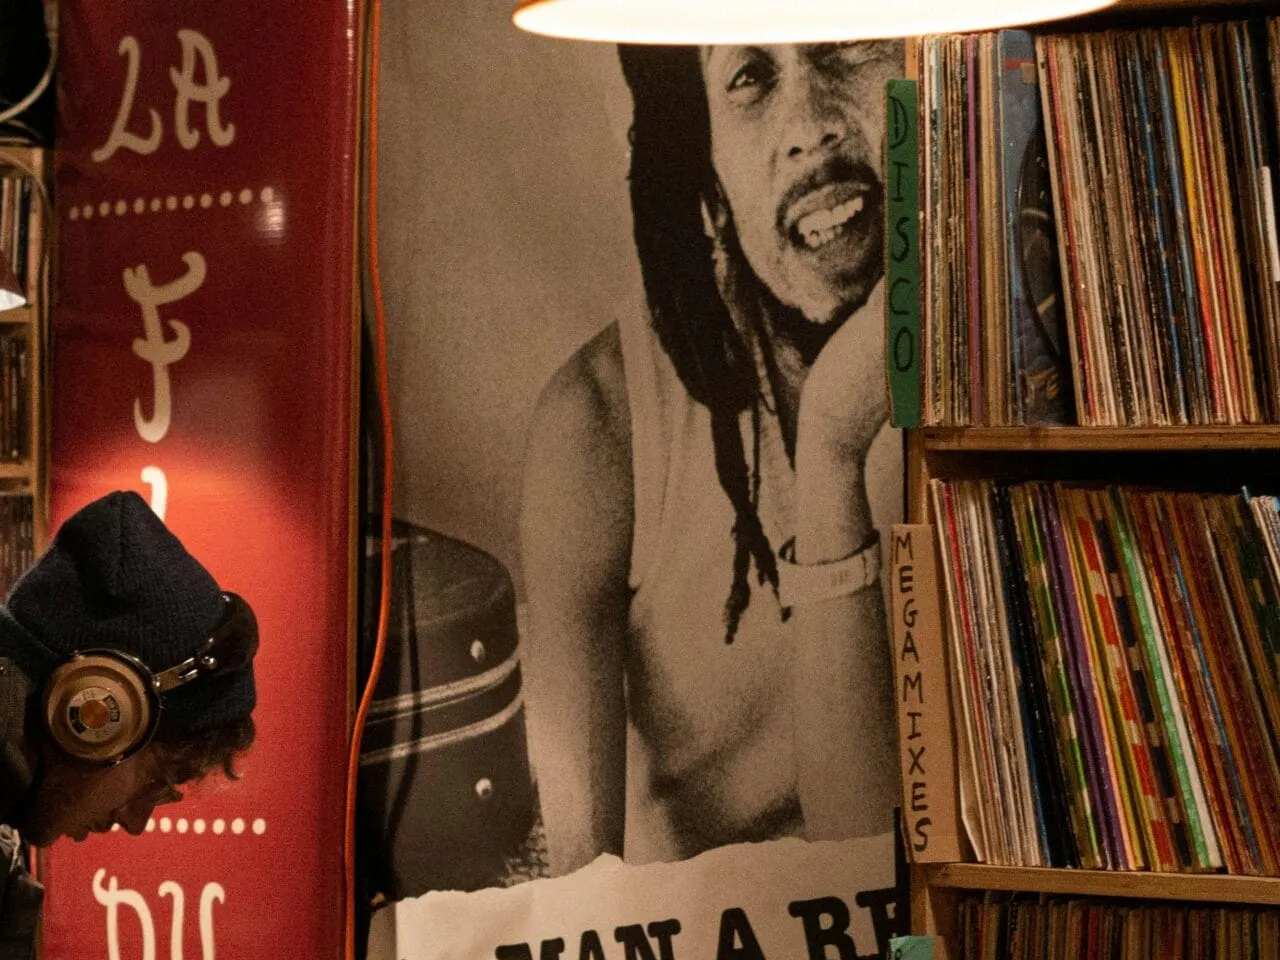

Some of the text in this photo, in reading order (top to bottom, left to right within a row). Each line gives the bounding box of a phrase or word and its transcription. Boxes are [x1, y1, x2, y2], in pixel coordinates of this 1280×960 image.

[91, 28, 237, 163] LA
[887, 94, 916, 374] DISCO
[895, 532, 933, 853] MEGAMIXES
